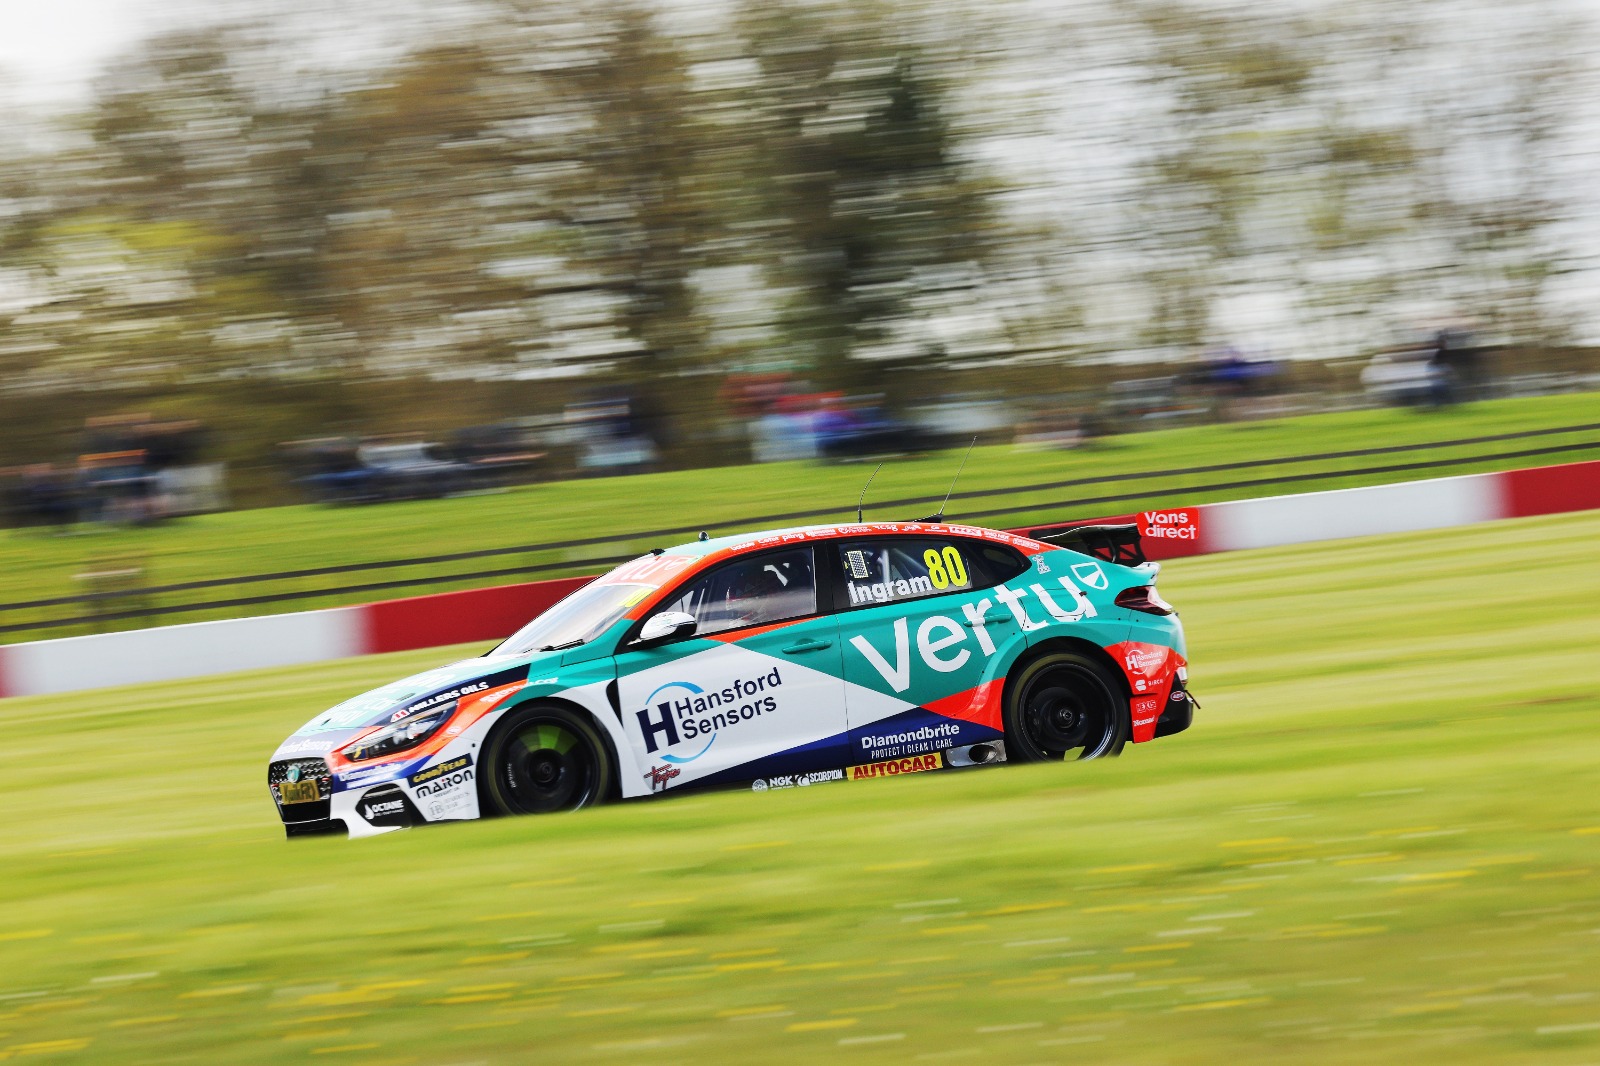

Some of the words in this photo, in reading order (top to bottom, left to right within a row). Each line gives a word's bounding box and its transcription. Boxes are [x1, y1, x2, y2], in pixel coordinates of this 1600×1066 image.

[1144, 511, 1189, 524] Vans
[1145, 524, 1197, 540] direct
[923, 546, 968, 590] 80
[848, 574, 933, 605] Ingram
[849, 575, 1098, 694] Vertu
[408, 689, 461, 712] MILLERS
[461, 681, 490, 695] OILS
[674, 666, 783, 719] Hansford
[635, 701, 681, 754] H
[682, 696, 777, 739] Sensors
[861, 724, 960, 749] Diamondbrite
[871, 746, 900, 760] PROTECT
[907, 741, 929, 754] CLEAN
[935, 738, 953, 749] CARE
[413, 758, 467, 782] GOODYEAR
[809, 769, 843, 783] SCORPION
[853, 754, 937, 780] AUTOCAR
[416, 769, 474, 799] MARON
[769, 775, 793, 787] NGK
[371, 799, 404, 813] OCTANE
